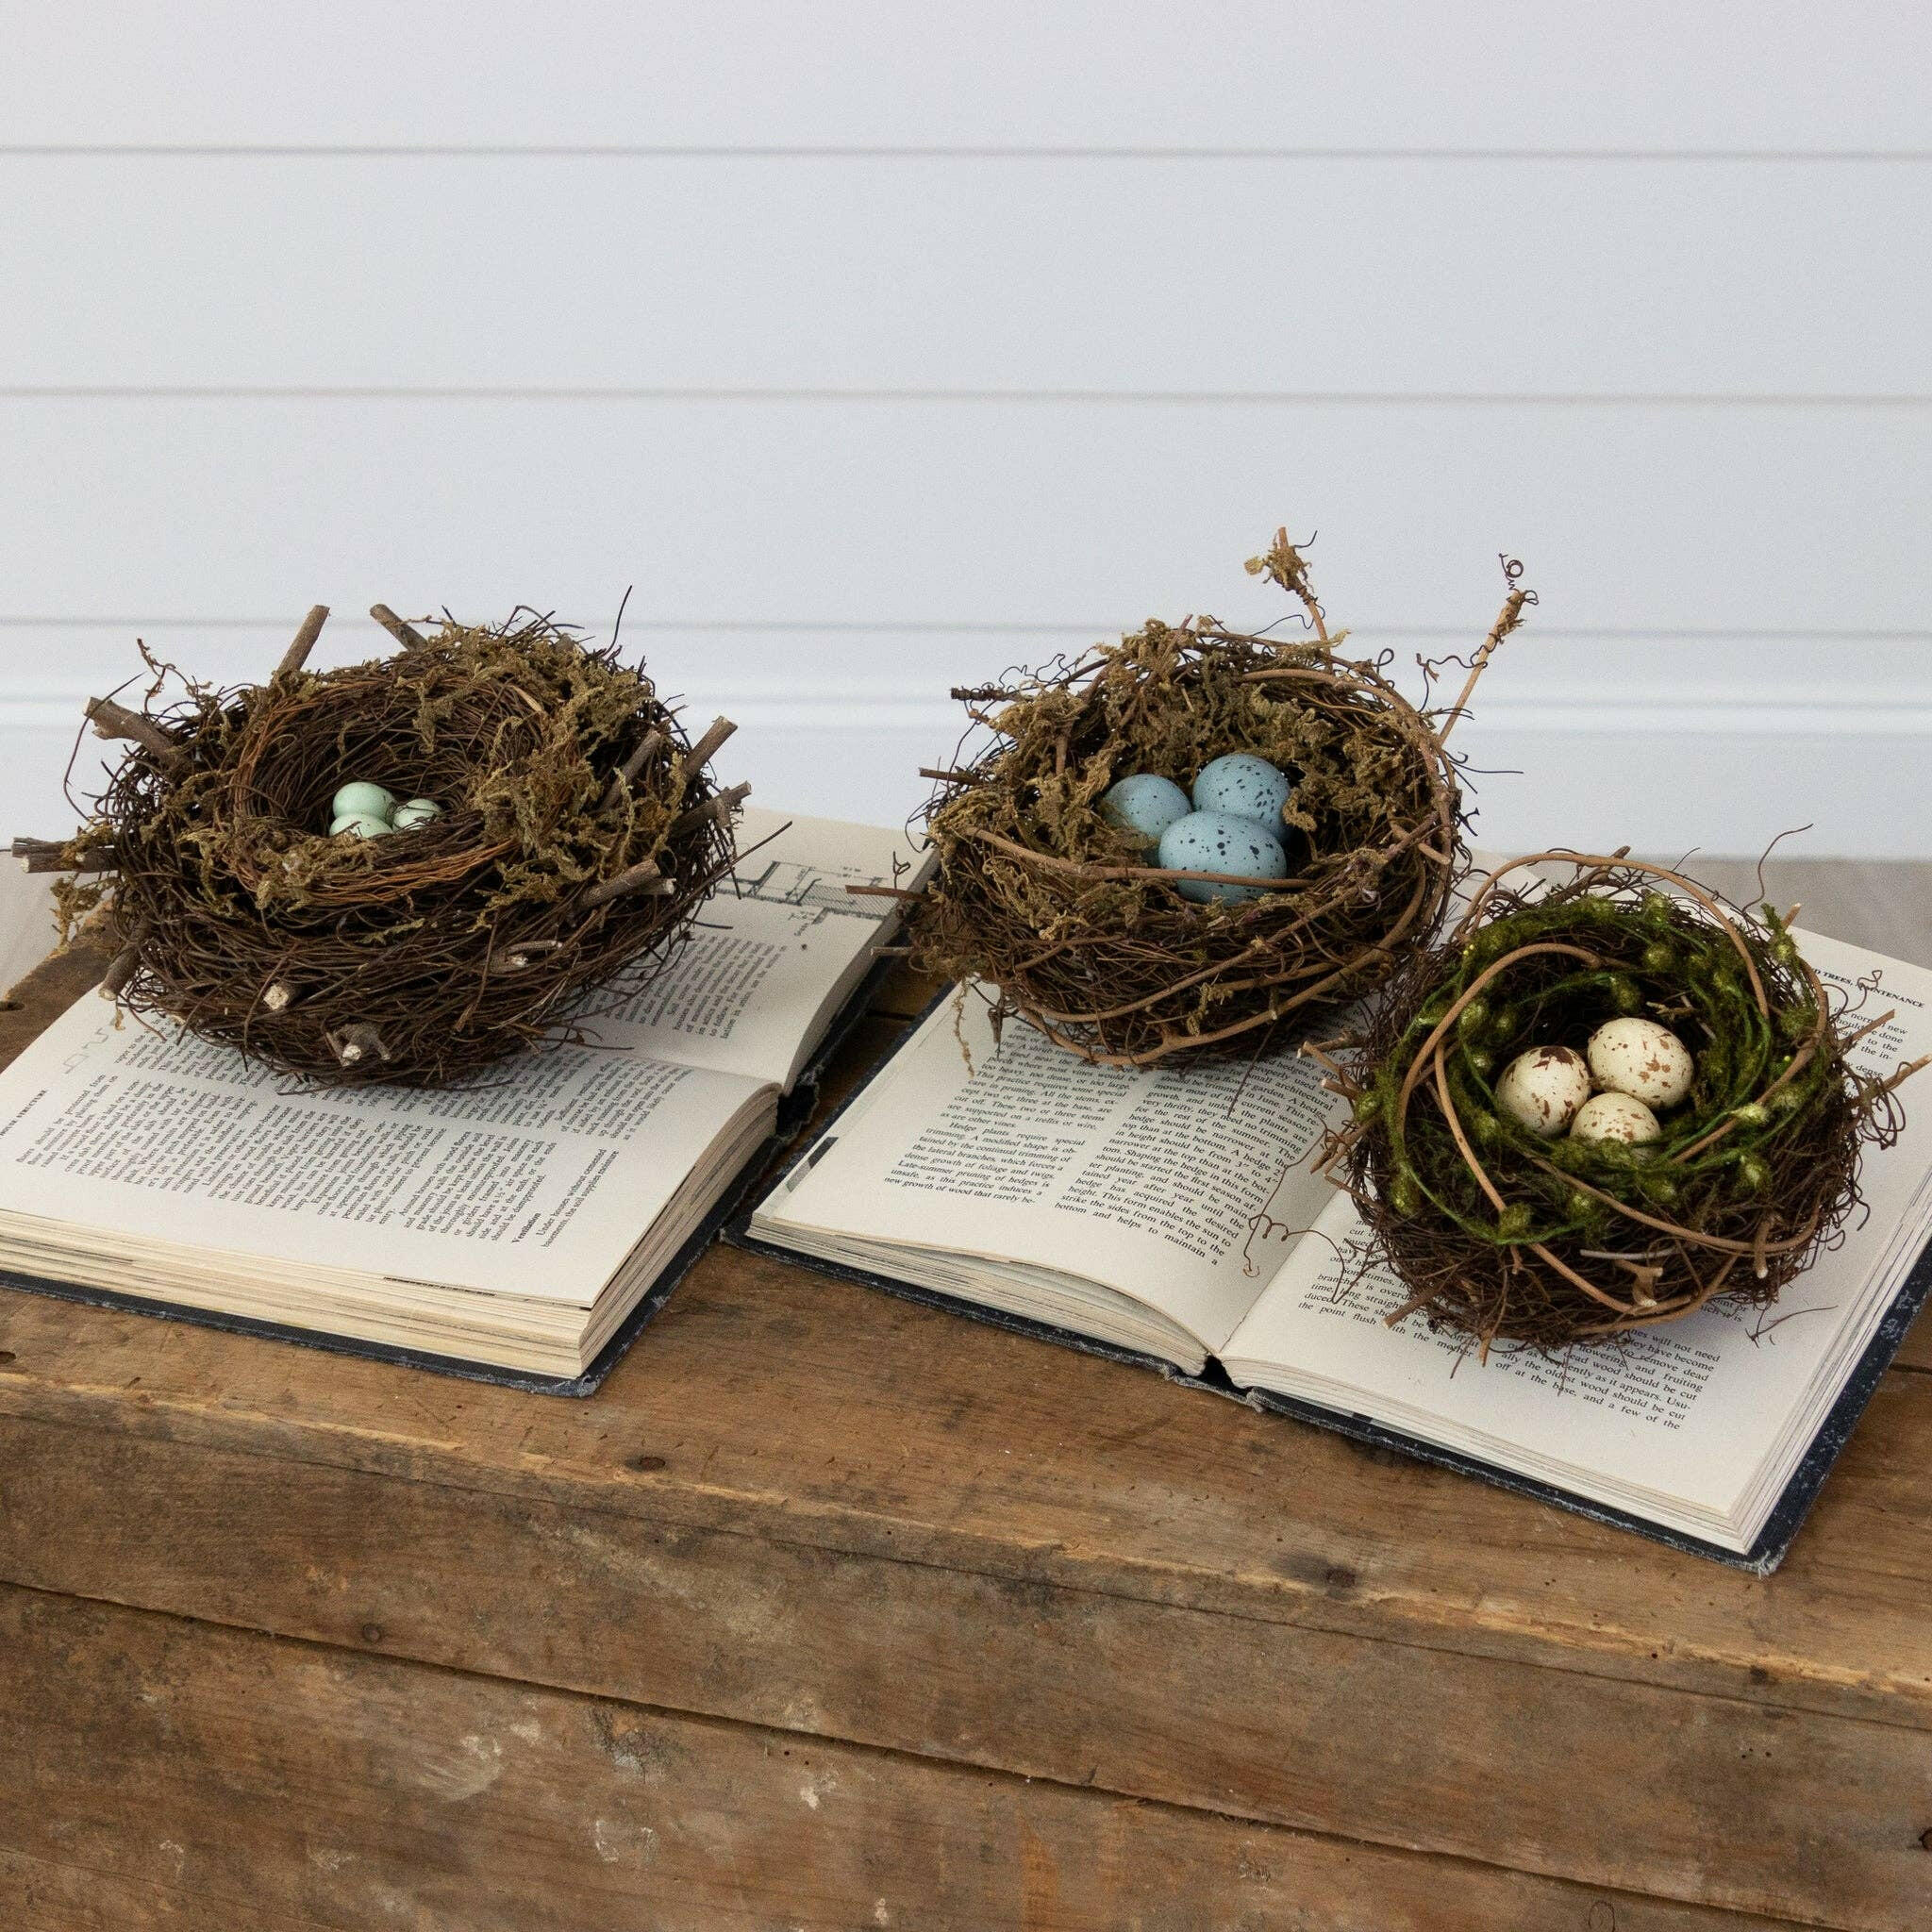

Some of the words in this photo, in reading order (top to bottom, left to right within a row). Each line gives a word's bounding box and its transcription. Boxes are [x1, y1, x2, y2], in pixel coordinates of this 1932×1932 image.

[1867, 1037, 1878, 1046] to
[1882, 1042, 1899, 1053] the
[1878, 1031, 1904, 1044] done
[1888, 1024, 1908, 1036] new
[1860, 1045, 1877, 1056] the
[1094, 1154, 1128, 1163] should
[1141, 1162, 1174, 1174] started
[1173, 1171, 1190, 1180] the
[1190, 1175, 1210, 1188] first
[1210, 1185, 1242, 1203] season
[1150, 1174, 1171, 1183] and
[1172, 1181, 1206, 1196] should
[1208, 1193, 1221, 1204] be
[1074, 1178, 1102, 1189] hedge
[1108, 1184, 1126, 1192] has
[1132, 1191, 1175, 1208] acquired
[1180, 1207, 1197, 1218] the
[1204, 1216, 1241, 1239] desired
[1079, 1172, 1111, 1180] tained
[1114, 1177, 1137, 1186] year
[1142, 1183, 1165, 1194] after
[1171, 1193, 1193, 1205] year
[1199, 1205, 1224, 1218] until
[1228, 1218, 1244, 1230] the
[1053, 1202, 1088, 1213] bottom
[1092, 1210, 1113, 1219] and
[1116, 1215, 1142, 1228] helps
[1147, 1226, 1159, 1235] to
[1163, 1234, 1207, 1257] maintain
[1089, 1199, 1106, 1208] the
[1107, 1204, 1131, 1214] sides
[1132, 1209, 1157, 1223] from
[1158, 1220, 1175, 1230] the
[1176, 1227, 1194, 1241] top
[1195, 1237, 1208, 1246] to
[1209, 1243, 1224, 1256] the
[1102, 1191, 1123, 1202] This
[1123, 1196, 1147, 1209] form
[1147, 1207, 1184, 1223] enables
[1184, 1220, 1201, 1231] the
[1201, 1228, 1220, 1241] sun
[1221, 1238, 1231, 1247] to
[1380, 1324, 1407, 1335] ith
[1647, 1342, 1672, 1358] have
[1674, 1352, 1713, 1372] become
[1651, 1335, 1672, 1346] will
[1673, 1342, 1690, 1353] not
[1694, 1349, 1721, 1362] need
[1526, 1350, 1538, 1359] as
[1594, 1374, 1606, 1384] as
[1608, 1377, 1617, 1387] it
[1591, 1361, 1621, 1376] wood
[1623, 1372, 1659, 1389] should
[1662, 1383, 1675, 1394] be
[1678, 1391, 1696, 1401] cut
[1634, 1364, 1656, 1376] and
[1662, 1372, 1703, 1393] fruiting
[1682, 1366, 1709, 1381] dead
[1494, 1362, 1511, 1374] off
[1513, 1370, 1524, 1378] at
[1529, 1374, 1545, 1387] the
[1582, 1394, 1604, 1406] and
[1620, 1404, 1640, 1418] few
[1644, 1414, 1658, 1424] of
[1662, 1419, 1679, 1430] the
[1501, 1352, 1519, 1367] ally
[1524, 1359, 1540, 1373] the
[1578, 1381, 1608, 1396] wood
[1611, 1391, 1648, 1408] should
[1651, 1402, 1664, 1414] be
[1668, 1410, 1685, 1420] cut
